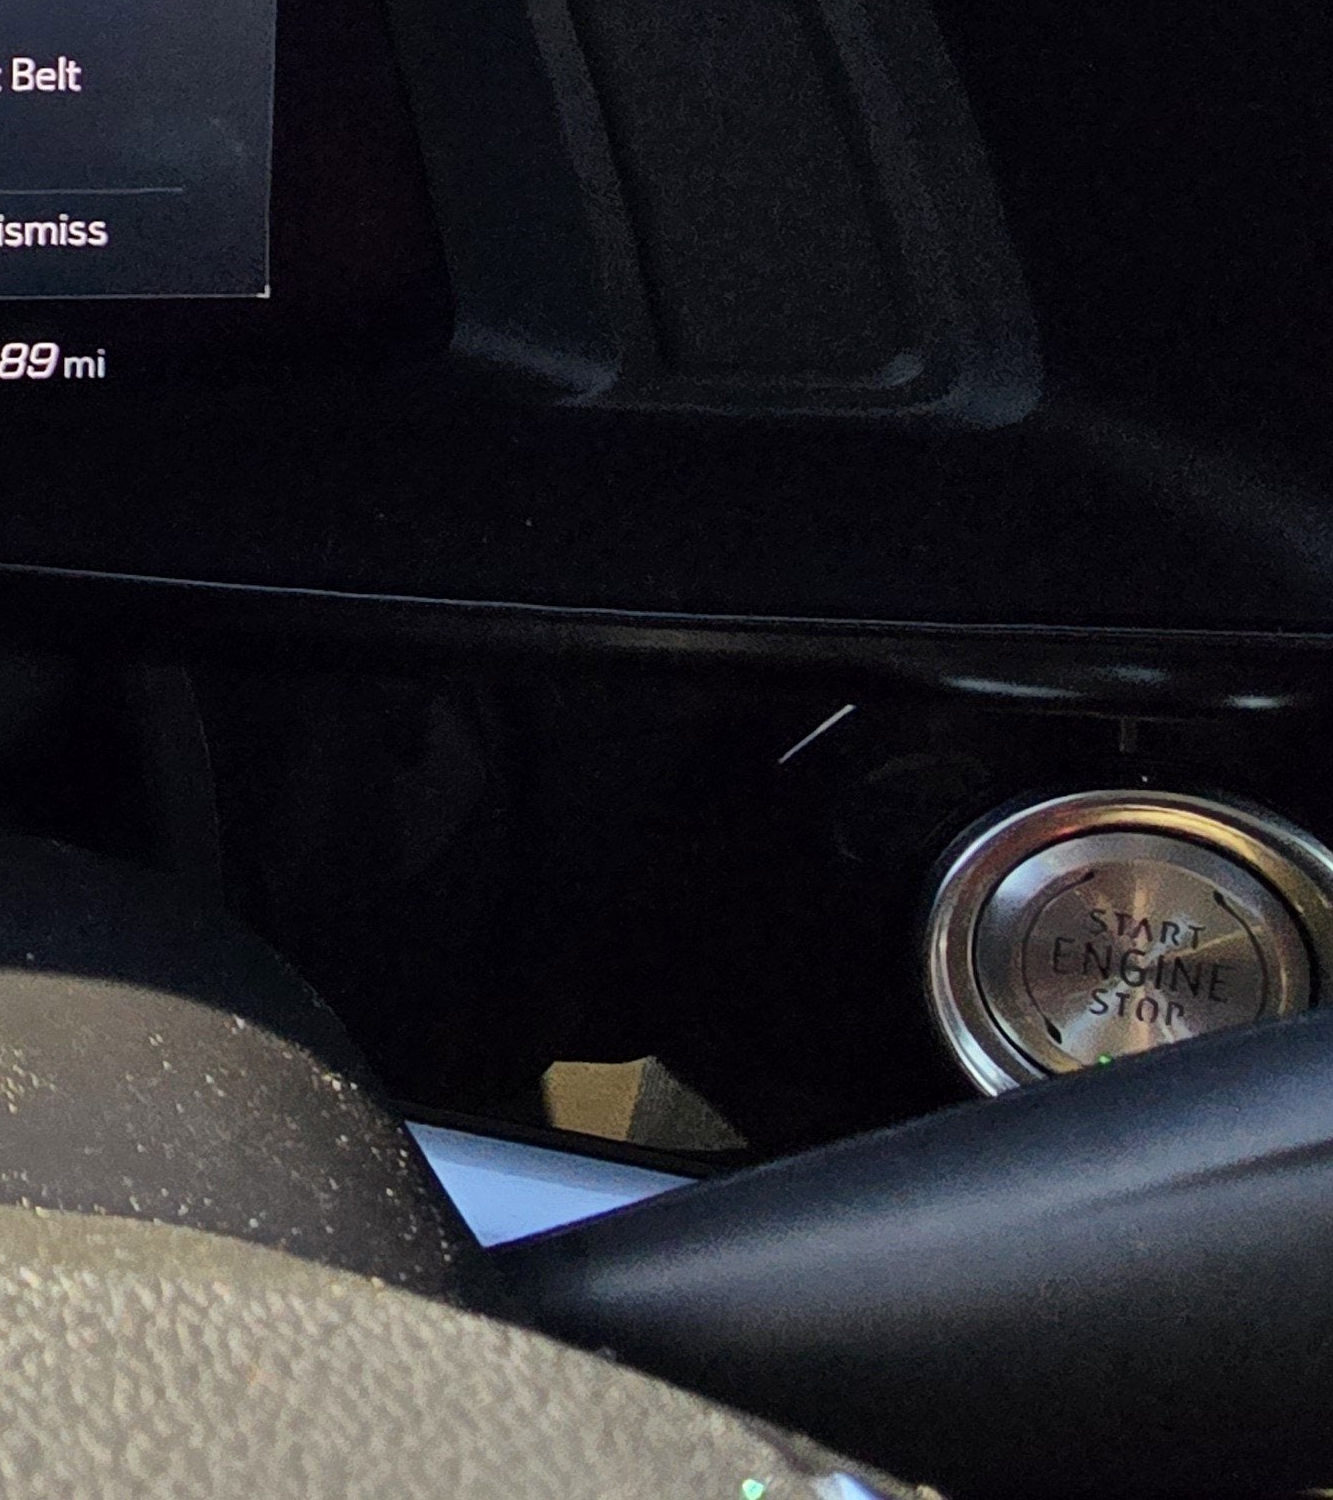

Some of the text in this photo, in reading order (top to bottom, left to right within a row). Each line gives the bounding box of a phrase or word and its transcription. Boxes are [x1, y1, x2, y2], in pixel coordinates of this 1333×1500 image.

[11, 56, 82, 92] Belt
[1089, 908, 1206, 949] START
[1052, 936, 1233, 1003] ENGINE
[1088, 988, 1185, 1026] STOP
